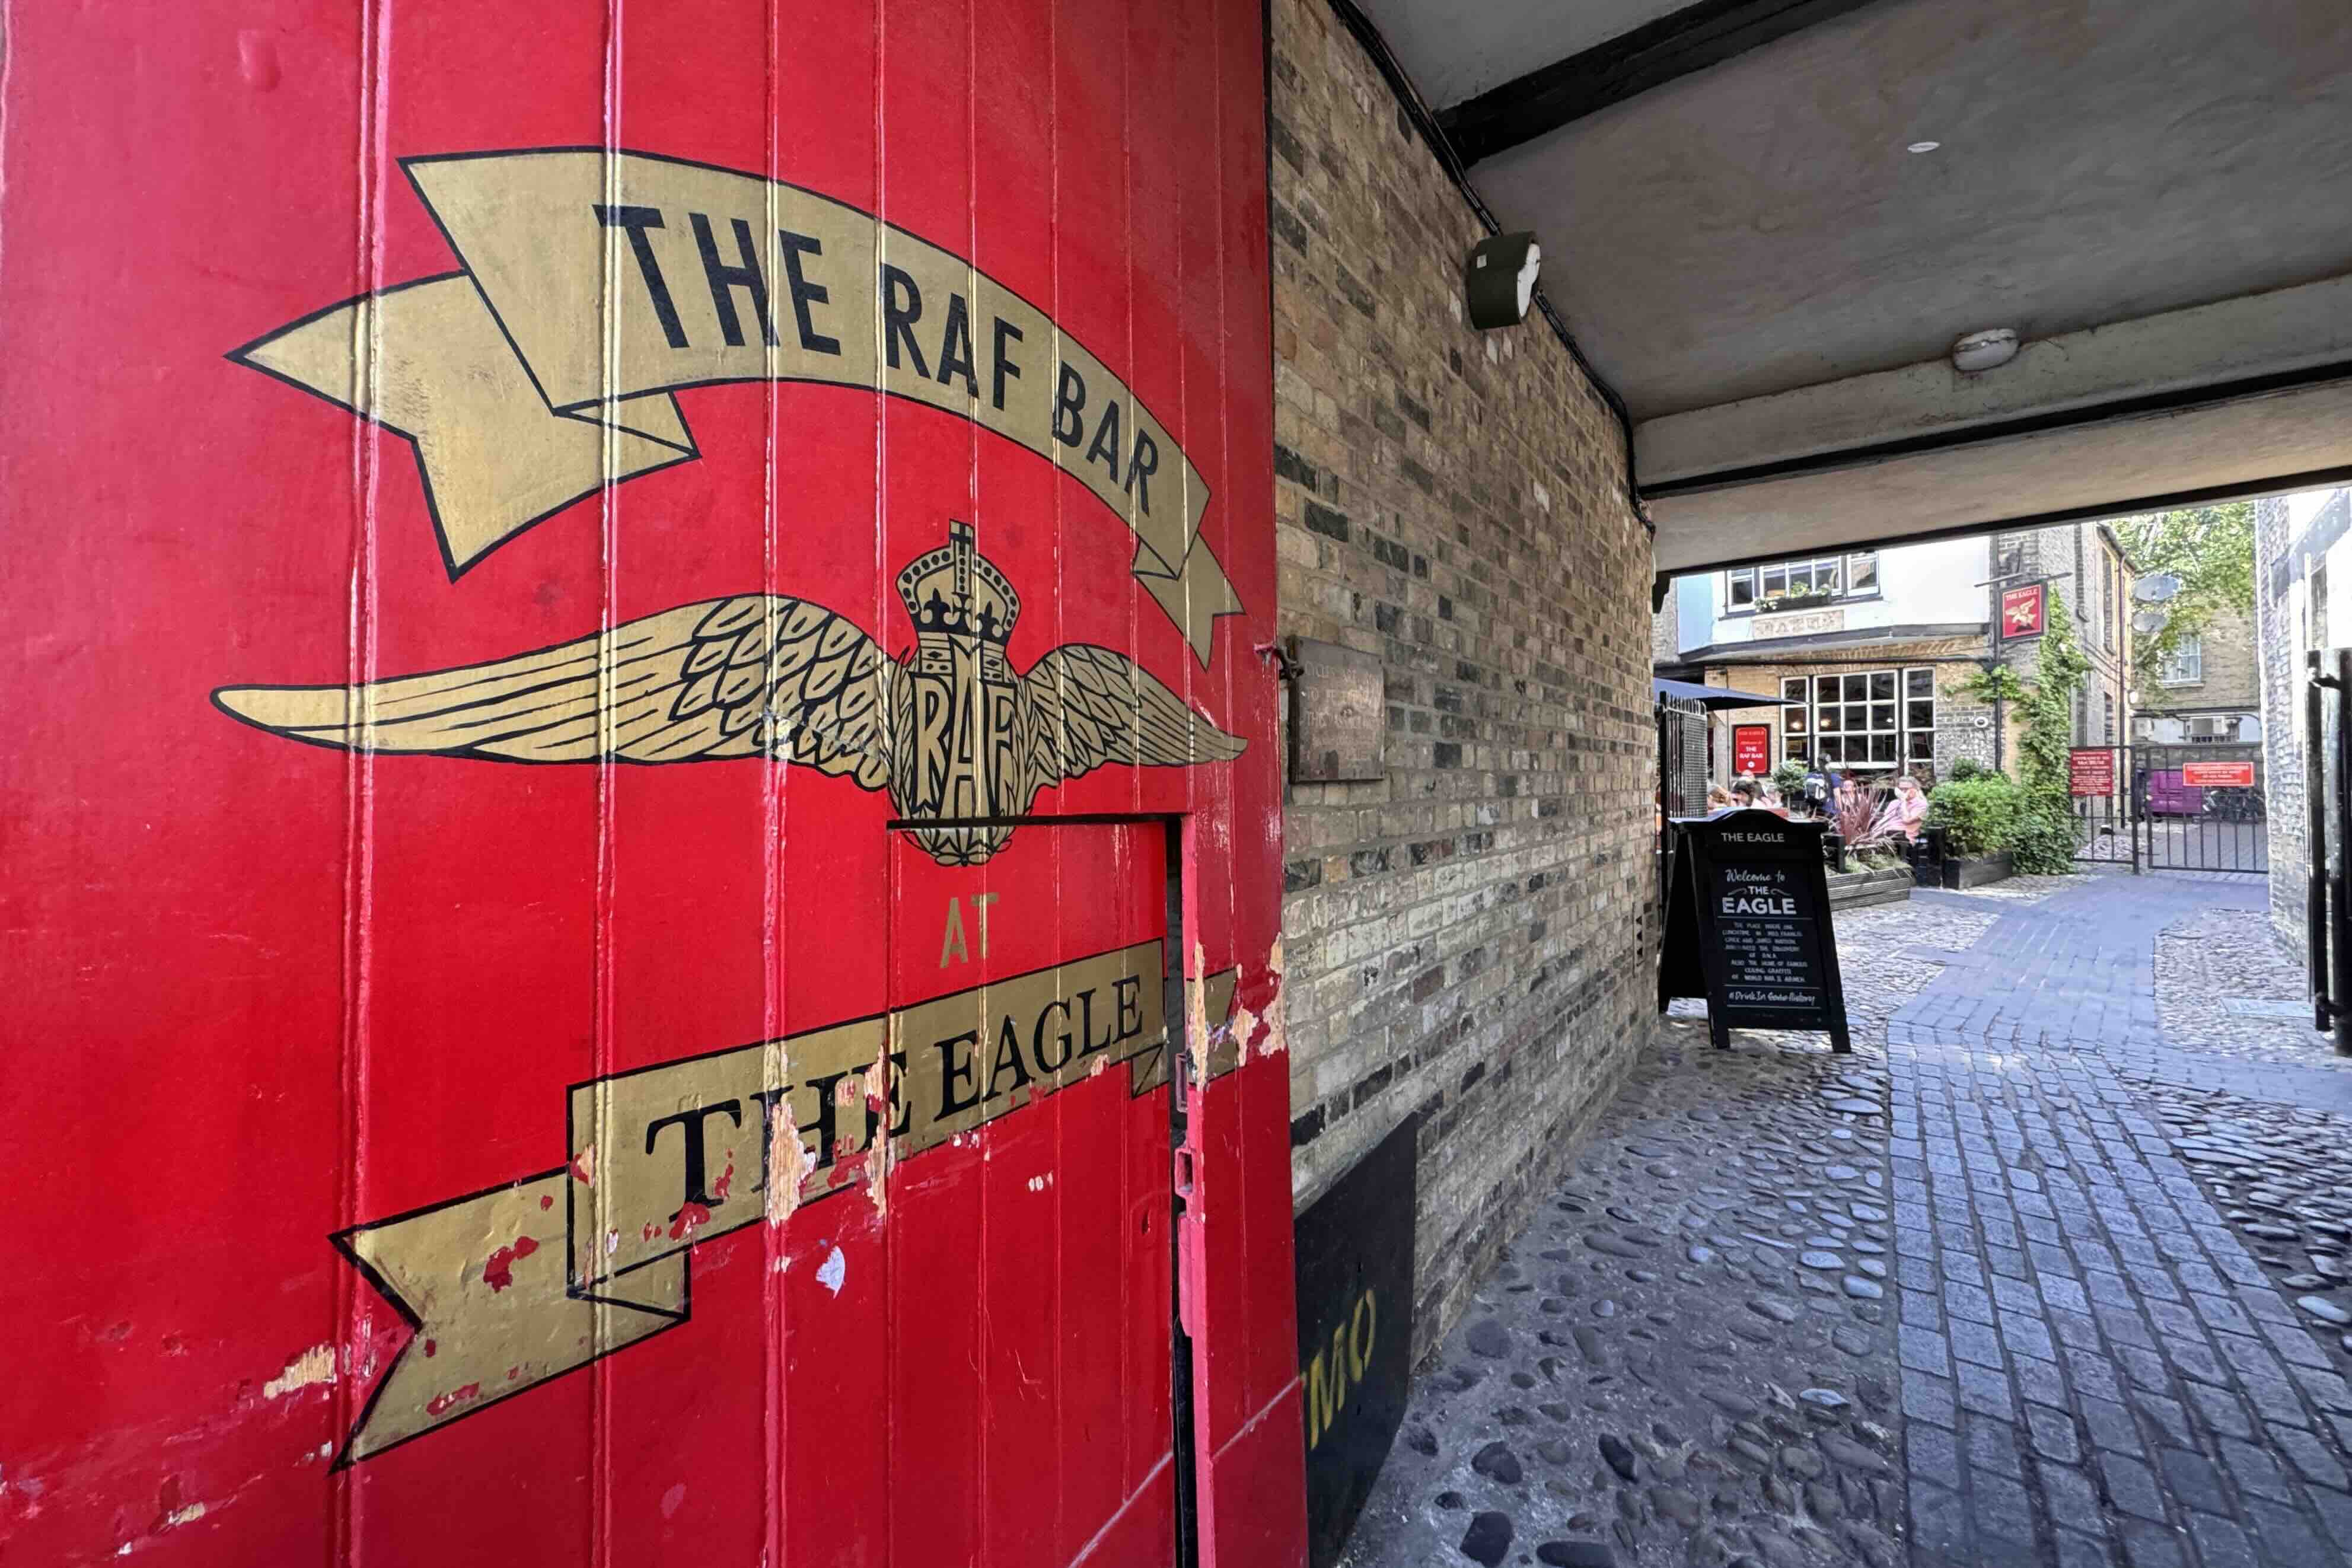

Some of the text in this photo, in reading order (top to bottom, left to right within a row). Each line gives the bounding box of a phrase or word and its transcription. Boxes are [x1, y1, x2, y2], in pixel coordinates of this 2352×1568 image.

[592, 204, 1159, 518] THE RAF BAR
[911, 632, 1018, 848] RAF
[1720, 832, 1784, 843] THE EAGLE
[1725, 868, 1786, 883] Welcome to
[1747, 885, 1770, 895] THE
[1722, 897, 1797, 915] EAGLE
[940, 892, 1000, 968] AT
[645, 975, 1143, 1223] THE EAGLE
